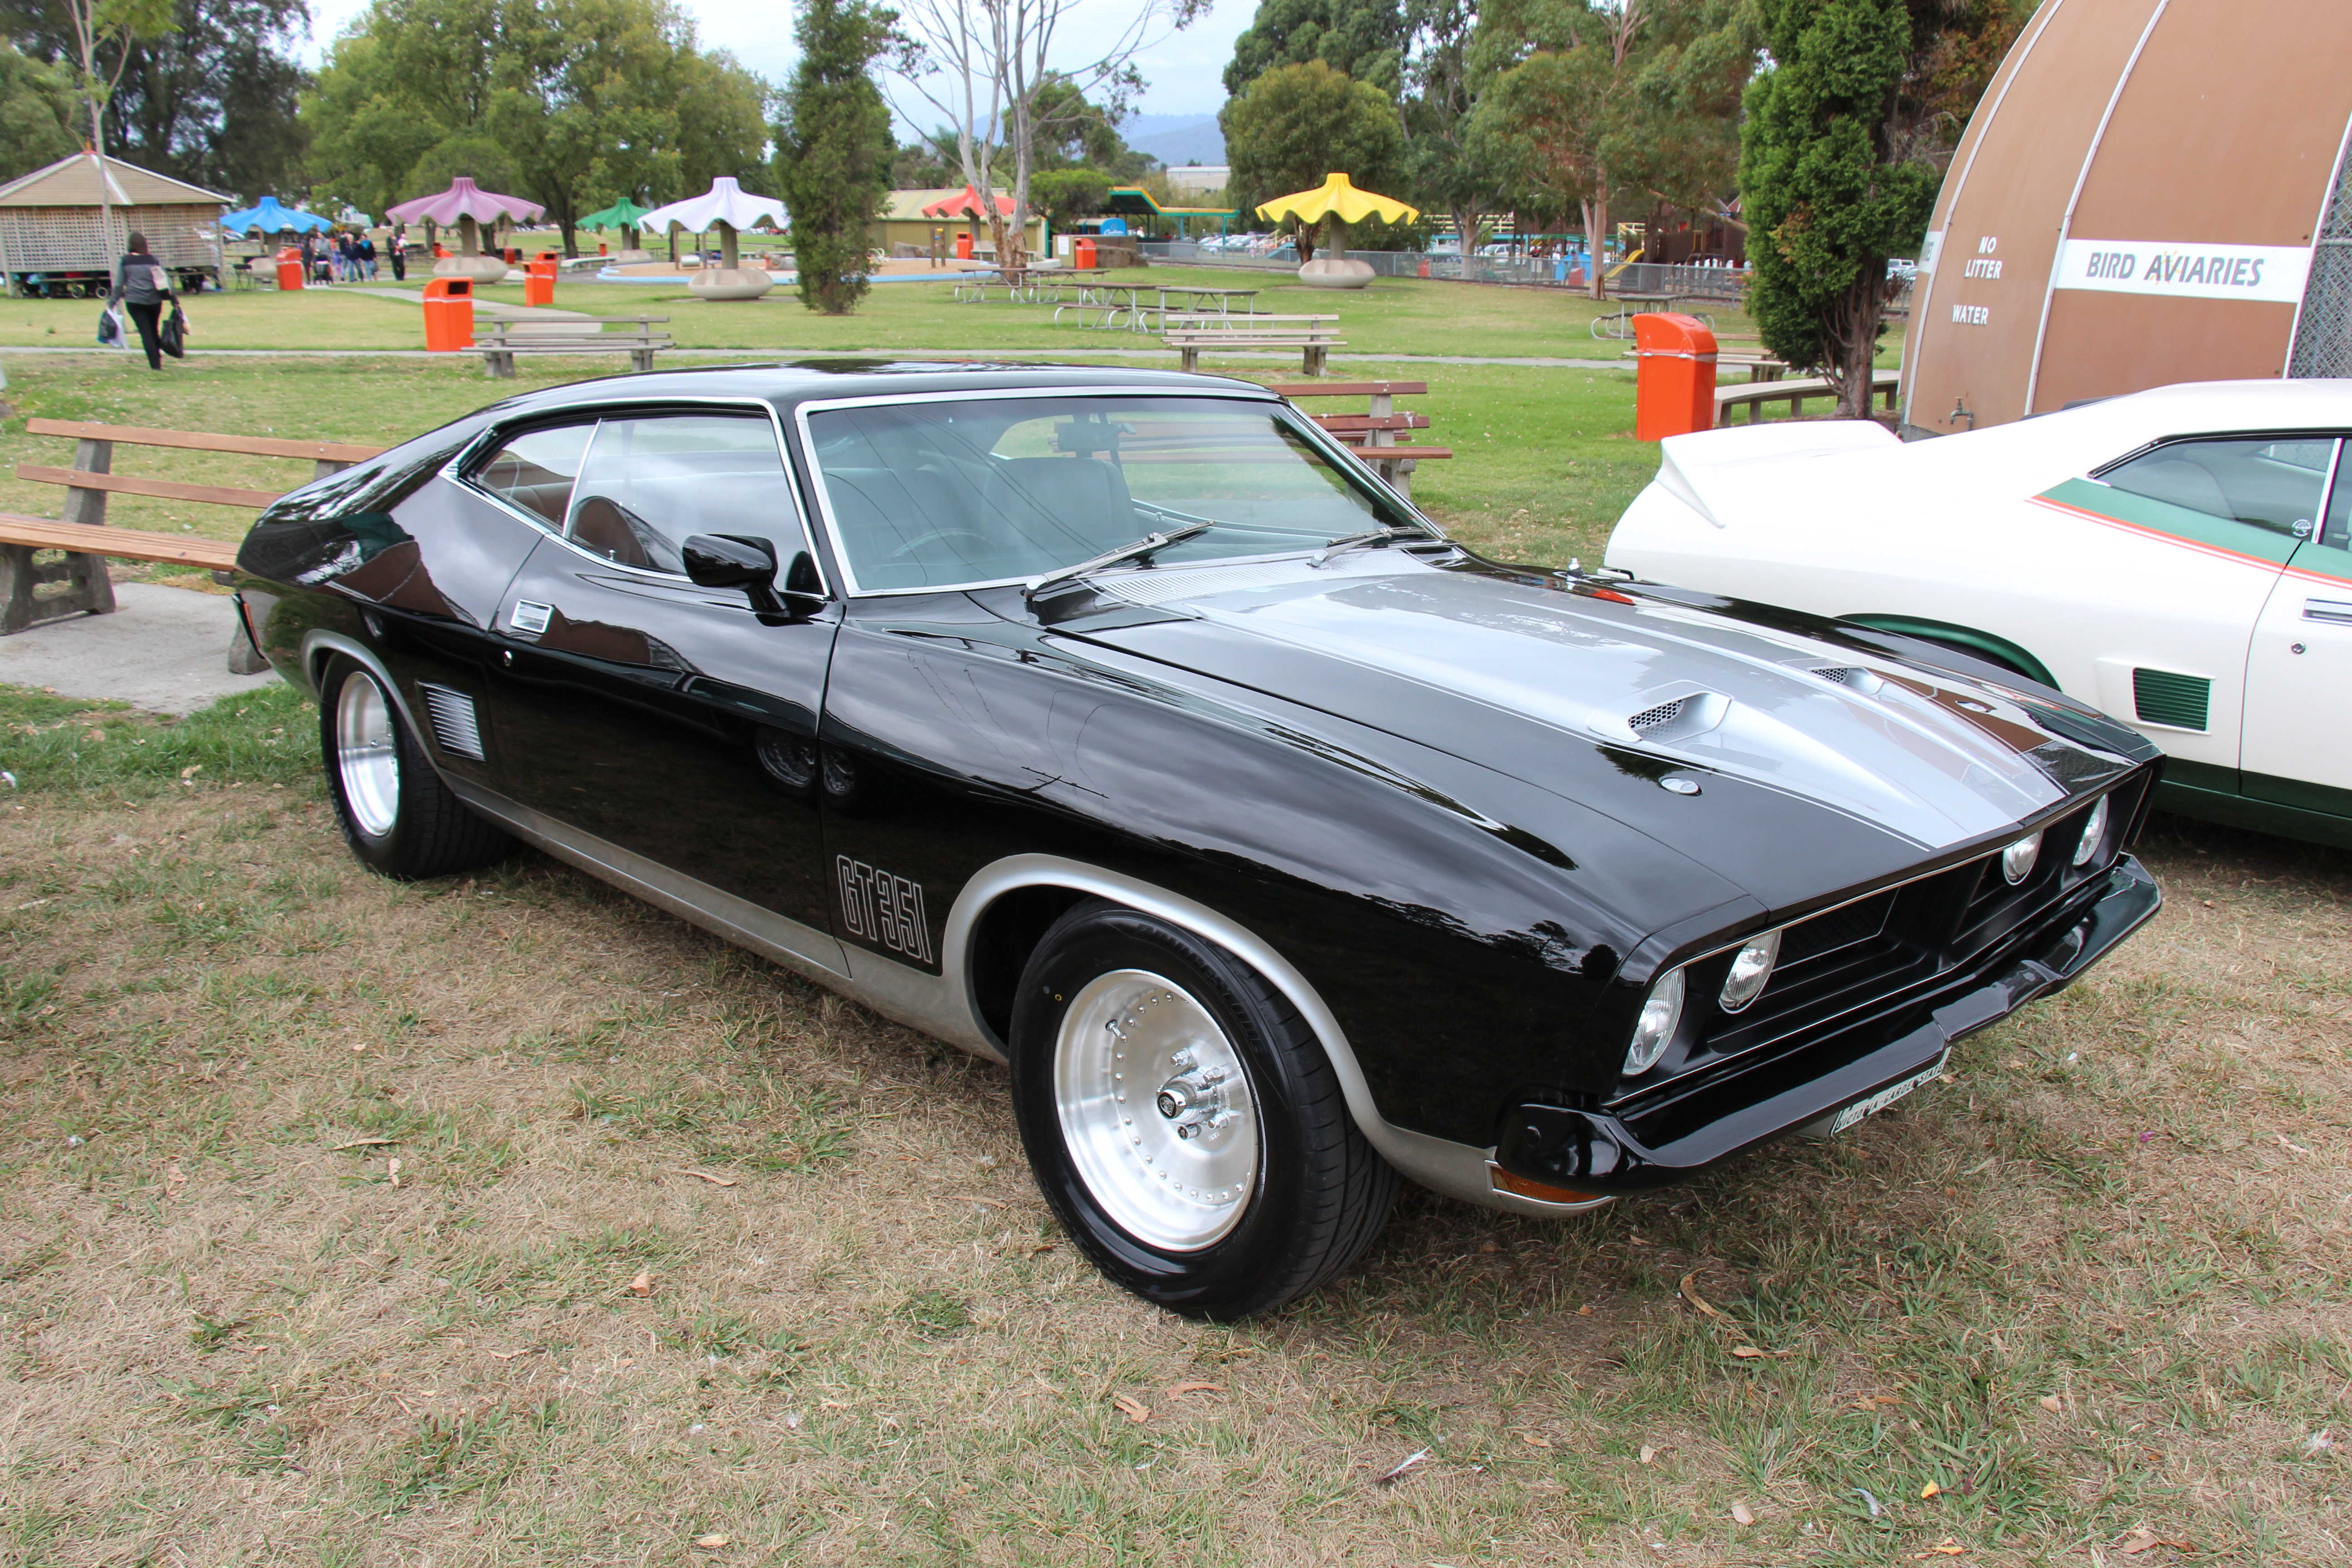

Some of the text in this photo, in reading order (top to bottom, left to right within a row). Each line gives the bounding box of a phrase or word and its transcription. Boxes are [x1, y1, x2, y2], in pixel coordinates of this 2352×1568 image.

[1978, 236, 1997, 254] NO
[1965, 259, 2003, 279] LITTER
[2086, 252, 2264, 287] BIRD AVIARIES
[1952, 304, 1989, 326] WATER
[1918, 1062, 1944, 1083] STATE
